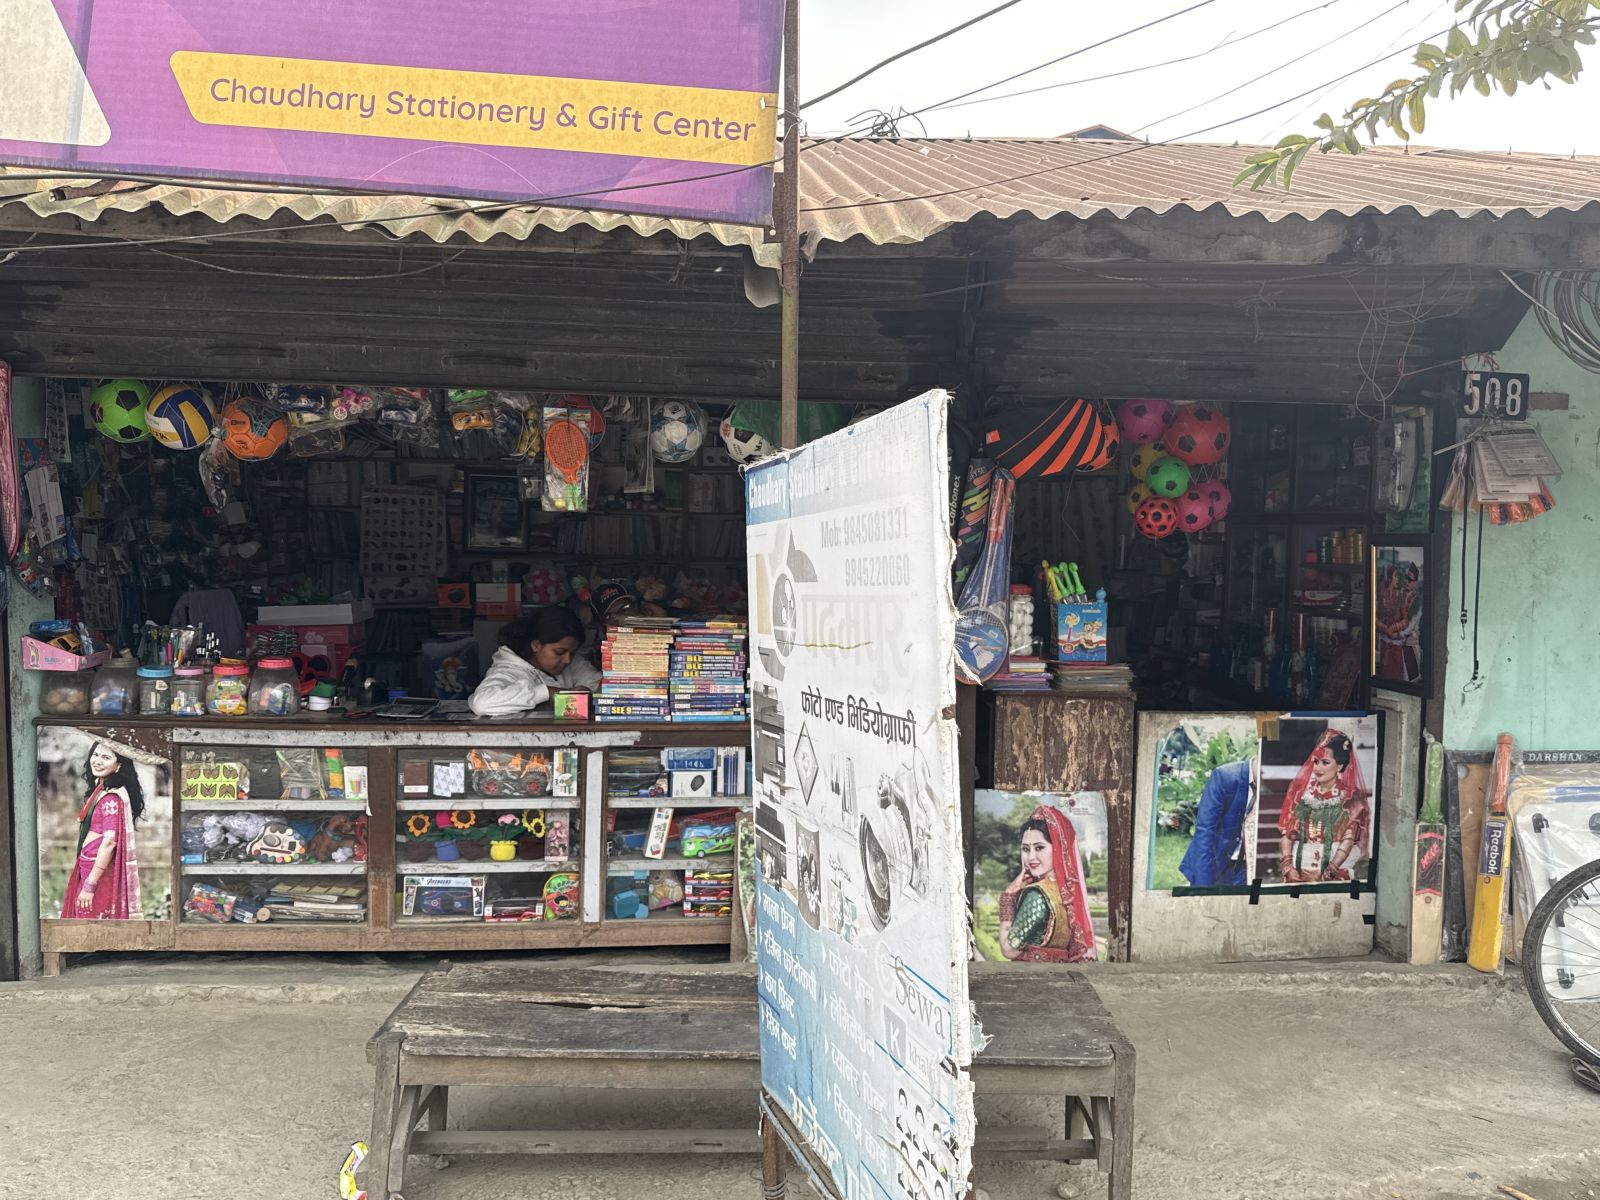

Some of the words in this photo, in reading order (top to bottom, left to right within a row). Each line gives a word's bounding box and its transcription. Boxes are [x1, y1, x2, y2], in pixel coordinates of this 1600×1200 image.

[209, 76, 377, 119] Chaudhary
[385, 89, 546, 133] Stationery
[555, 101, 578, 129] &
[587, 104, 644, 133] Gift
[653, 111, 758, 143] Center
[1463, 372, 1522, 416] 508
[749, 473, 787, 510] Chaudhary
[949, 475, 960, 526] Carbonex
[820, 520, 843, 548] Mob:
[843, 507, 909, 546] 9845081331
[801, 685, 822, 719] फोटो
[824, 697, 845, 726] एण्ड
[1528, 752, 1582, 762] DARSHAN
[1487, 828, 1502, 875] Reebok
[828, 947, 851, 990] फोटो
